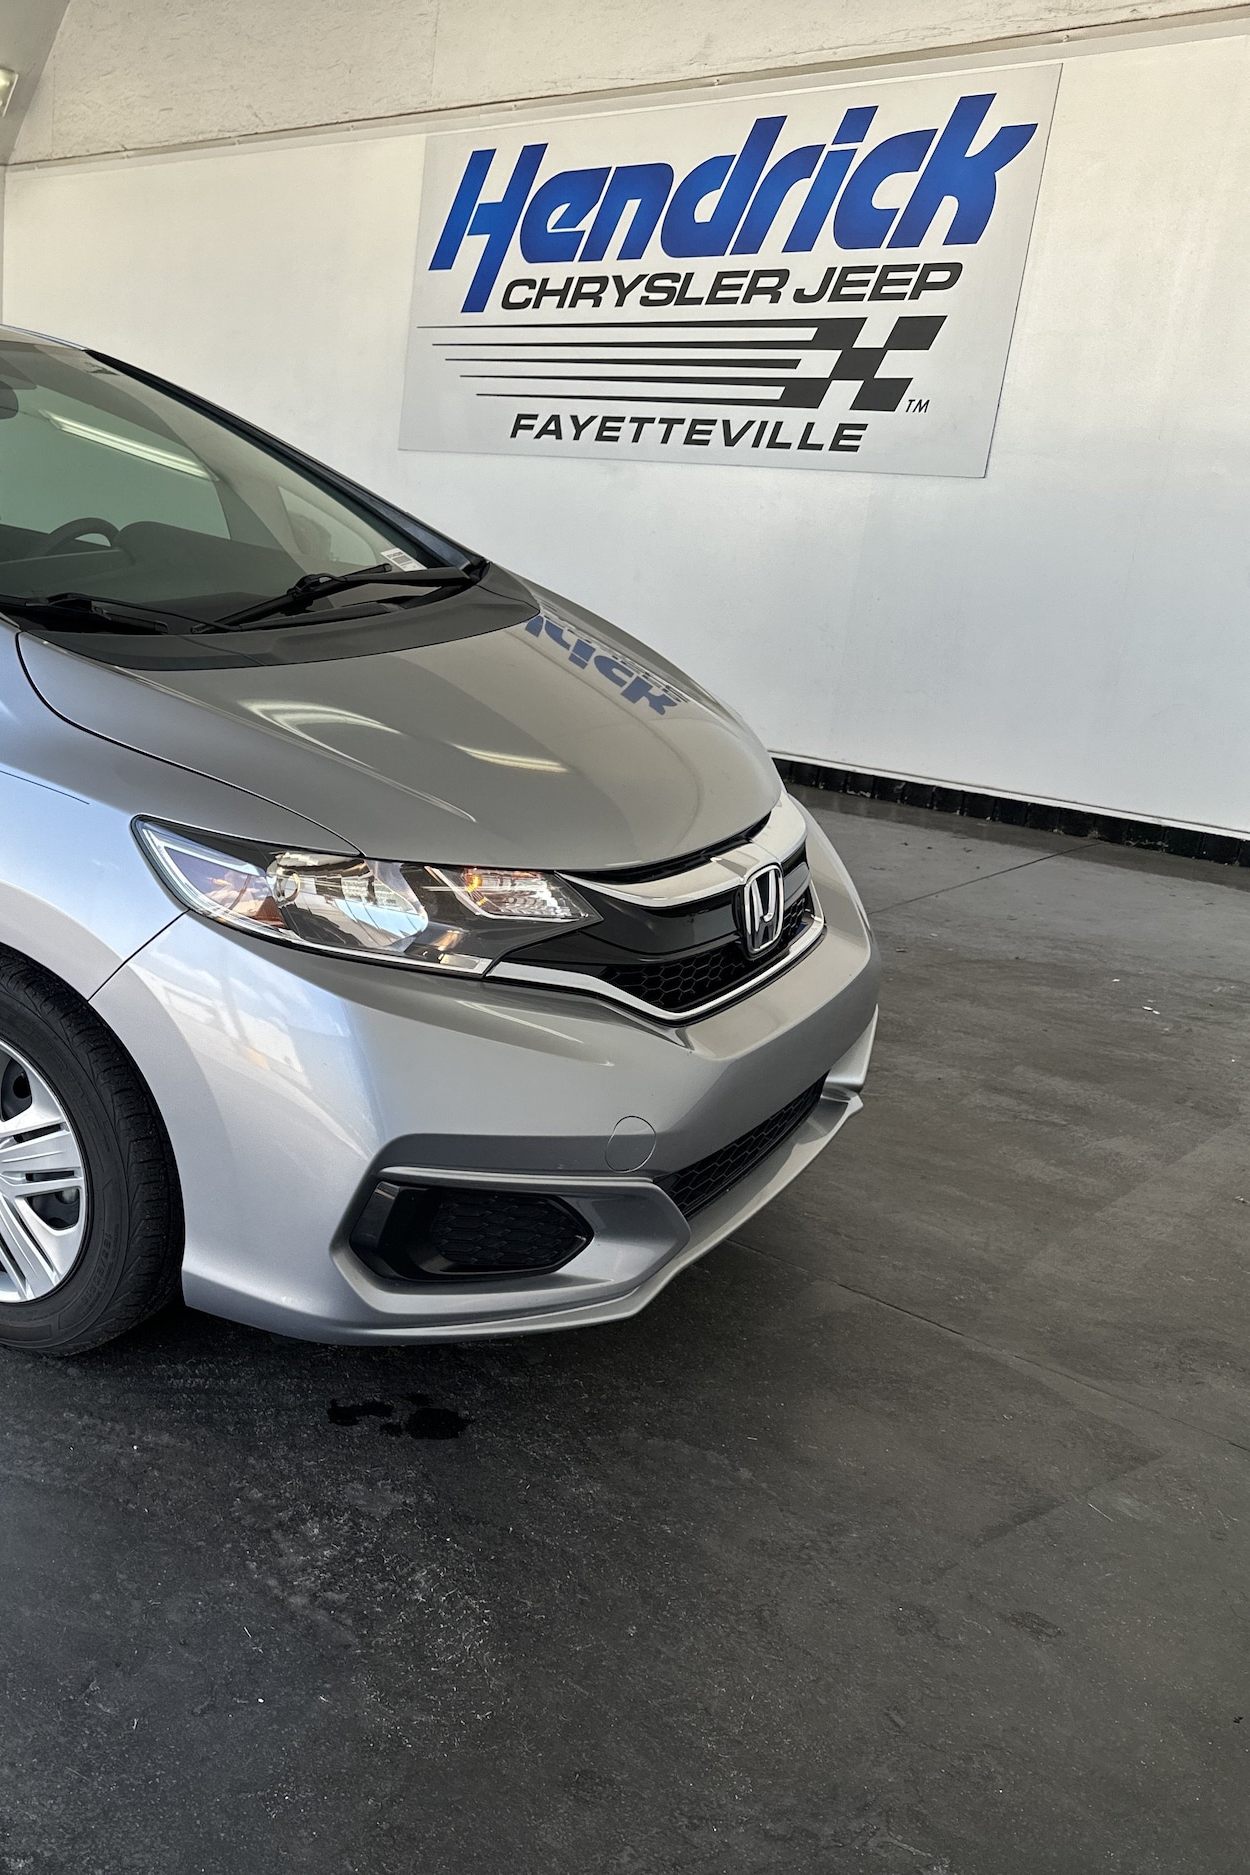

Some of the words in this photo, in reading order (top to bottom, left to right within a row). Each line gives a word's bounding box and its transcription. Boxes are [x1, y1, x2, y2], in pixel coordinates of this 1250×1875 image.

[428, 93, 1038, 314] Hendrick
[501, 267, 790, 311] CHRYSLER
[793, 261, 964, 304] JEEP
[905, 399, 930, 414] TM
[509, 413, 869, 453] FAYETTEVILLE
